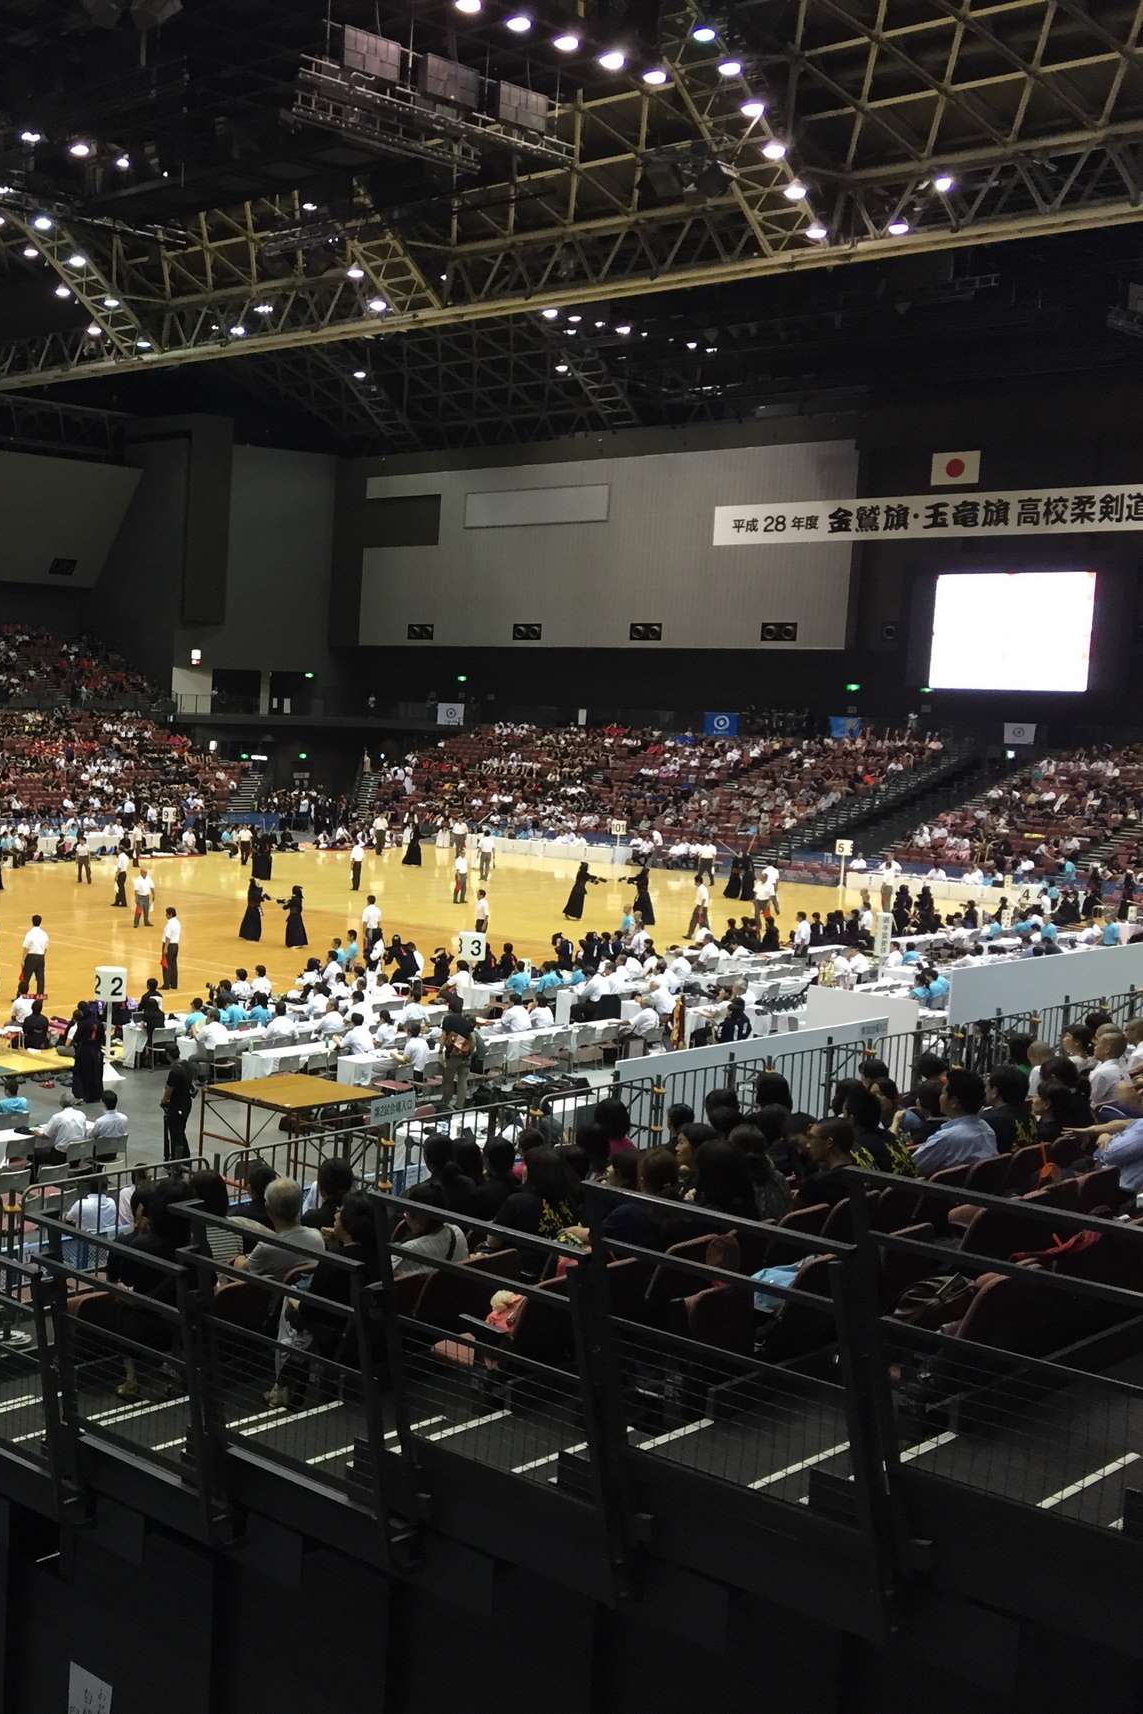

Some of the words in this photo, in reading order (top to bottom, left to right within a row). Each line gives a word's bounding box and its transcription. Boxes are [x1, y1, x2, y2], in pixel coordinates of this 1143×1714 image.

[1022, 889, 1030, 900] 4
[470, 939, 482, 956] 3
[110, 976, 123, 996] 2
